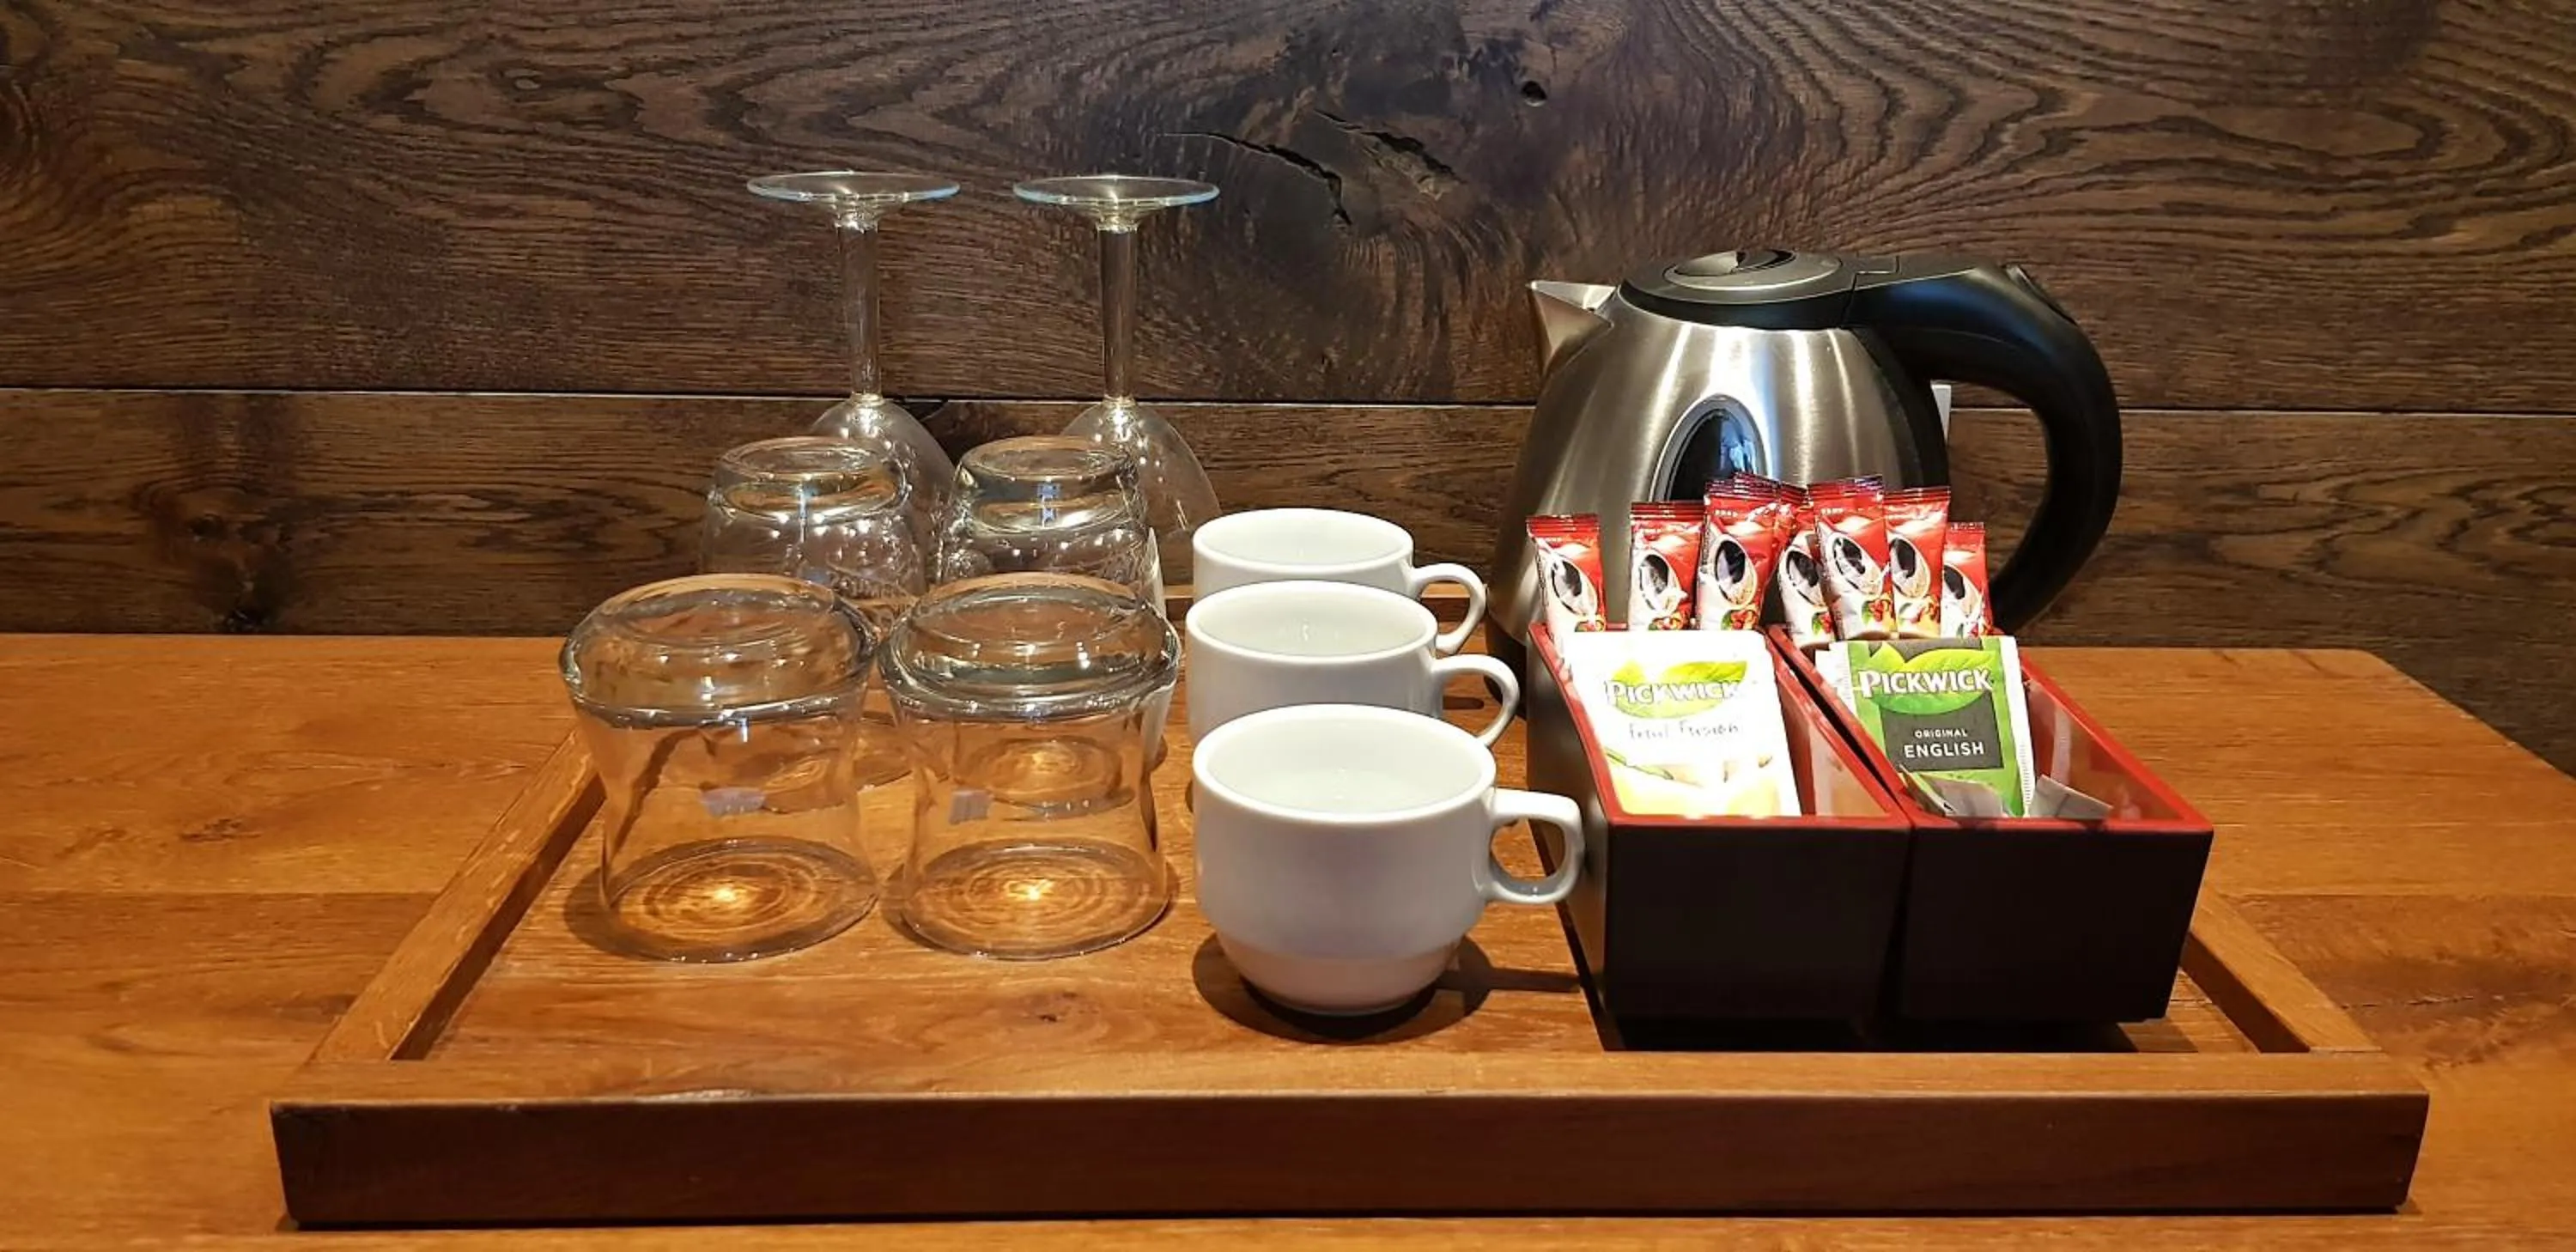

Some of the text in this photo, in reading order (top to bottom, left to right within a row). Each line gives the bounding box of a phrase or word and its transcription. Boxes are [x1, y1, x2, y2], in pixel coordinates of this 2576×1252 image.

[1603, 679, 1741, 707] PICKWICK
[1858, 668, 1993, 698] PICKWICK
[1915, 729, 1968, 738] ORIGINAL
[1904, 742, 1984, 758] ENGLISH
